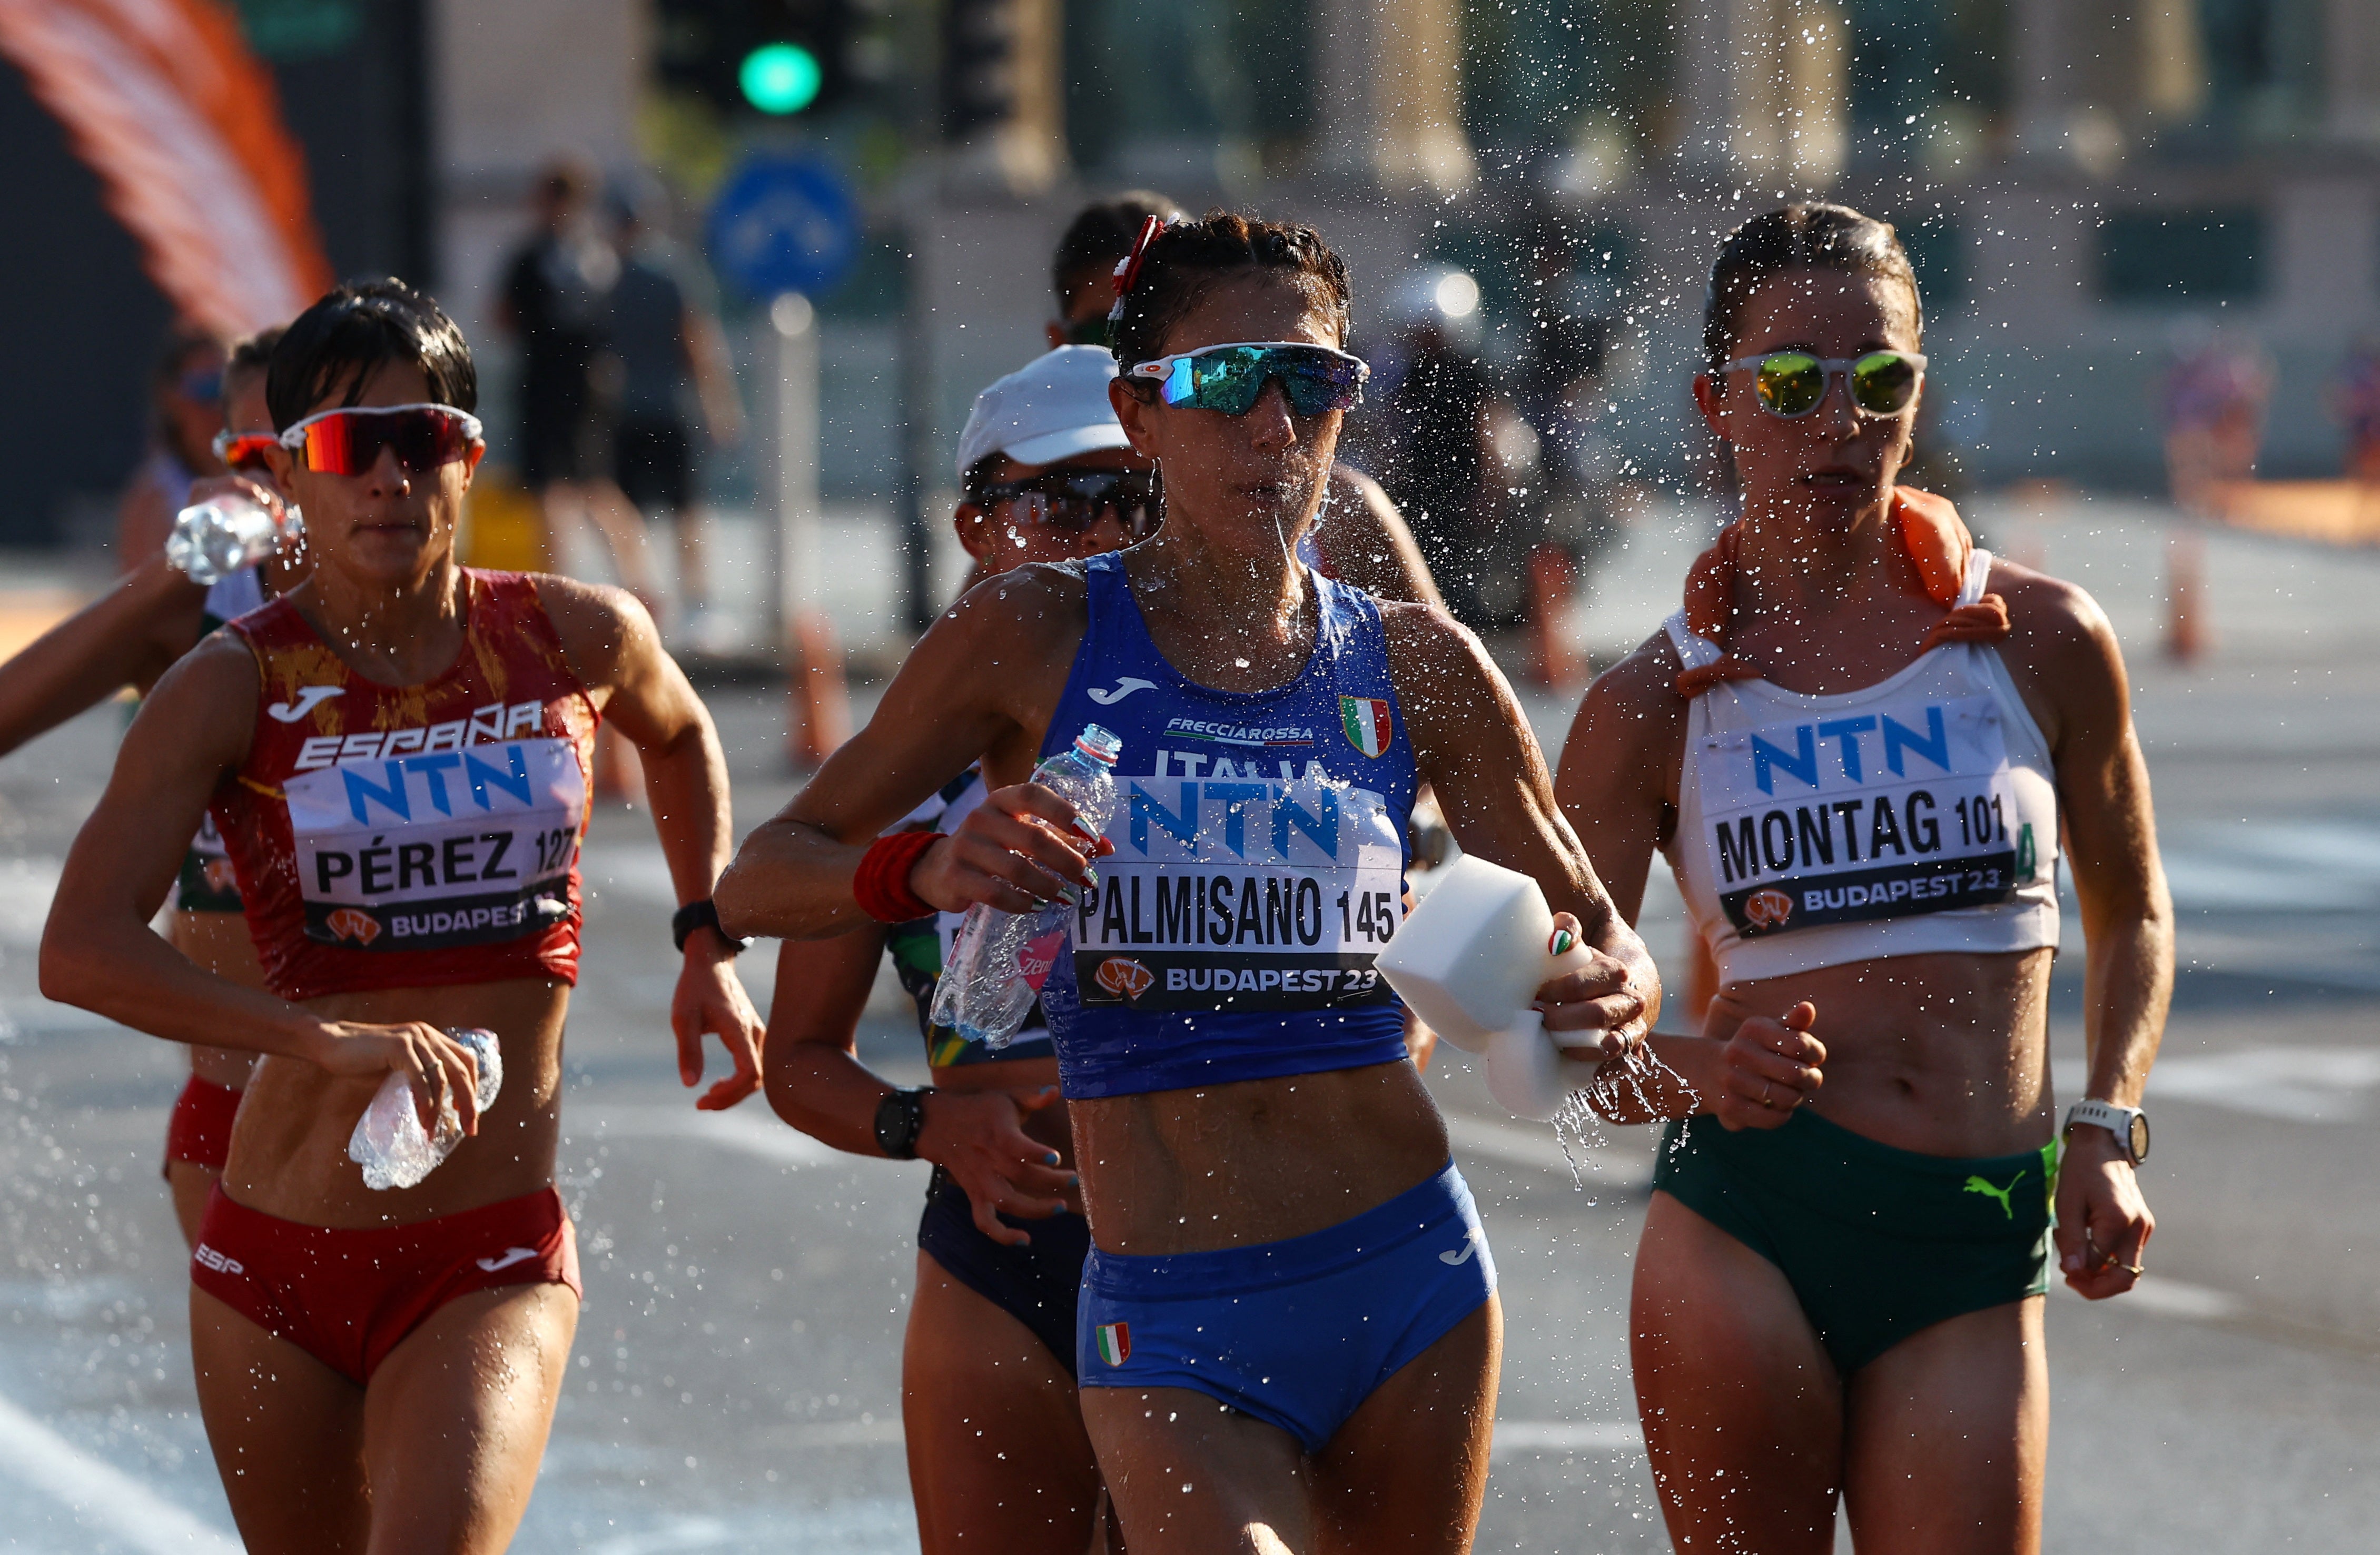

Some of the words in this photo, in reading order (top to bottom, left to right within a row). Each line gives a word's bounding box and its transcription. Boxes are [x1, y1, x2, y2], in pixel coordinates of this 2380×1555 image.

[293, 699, 542, 770] ESPAÑA
[1167, 718, 1314, 740] FRECCIAROSSA
[1751, 706, 1951, 796] NTN
[342, 746, 533, 827] NTN
[1130, 780, 1338, 862] NTN
[316, 831, 517, 895] PÉREZ
[536, 827, 575, 874] 127
[1716, 790, 1941, 883] MONTAG
[1956, 794, 2004, 846] 101
[1078, 875, 1322, 946] PALMISANO
[1337, 892, 1395, 943] 145
[1804, 871, 1963, 912] BUDAPEST
[1166, 968, 1340, 993] BUDAPEST
[194, 1242, 244, 1275] ESP
